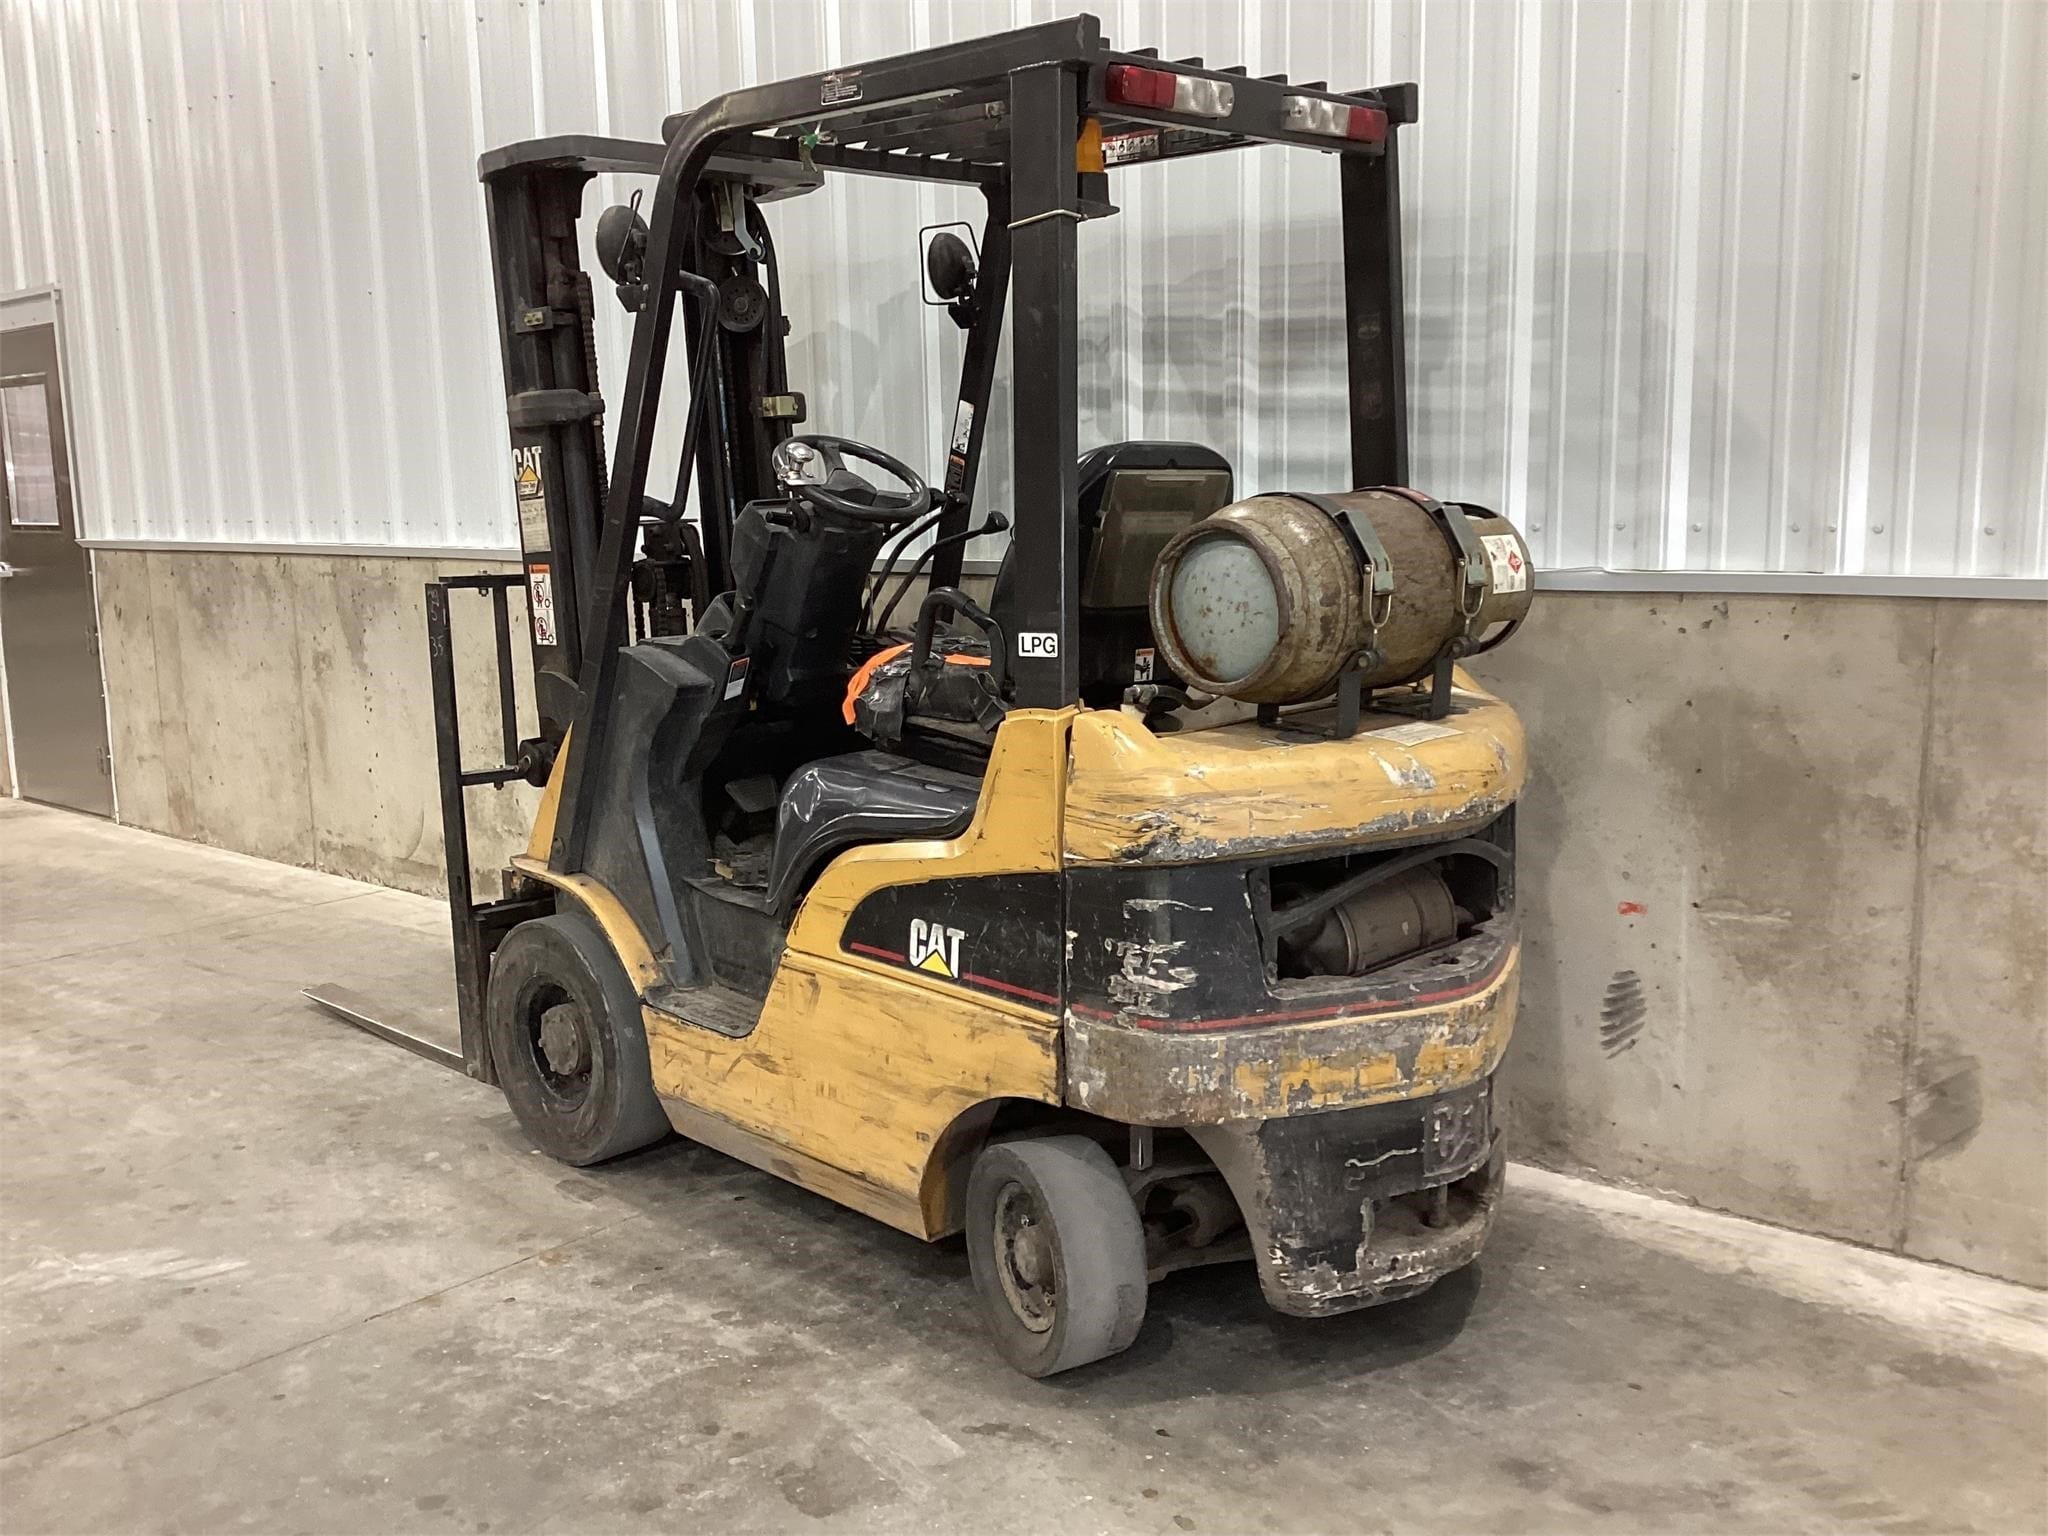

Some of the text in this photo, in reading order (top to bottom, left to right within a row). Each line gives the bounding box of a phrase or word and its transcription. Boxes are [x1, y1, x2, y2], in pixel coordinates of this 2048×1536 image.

[512, 446, 542, 482] CAT
[1021, 636, 1055, 654] LPG
[909, 918, 965, 979] CAT
